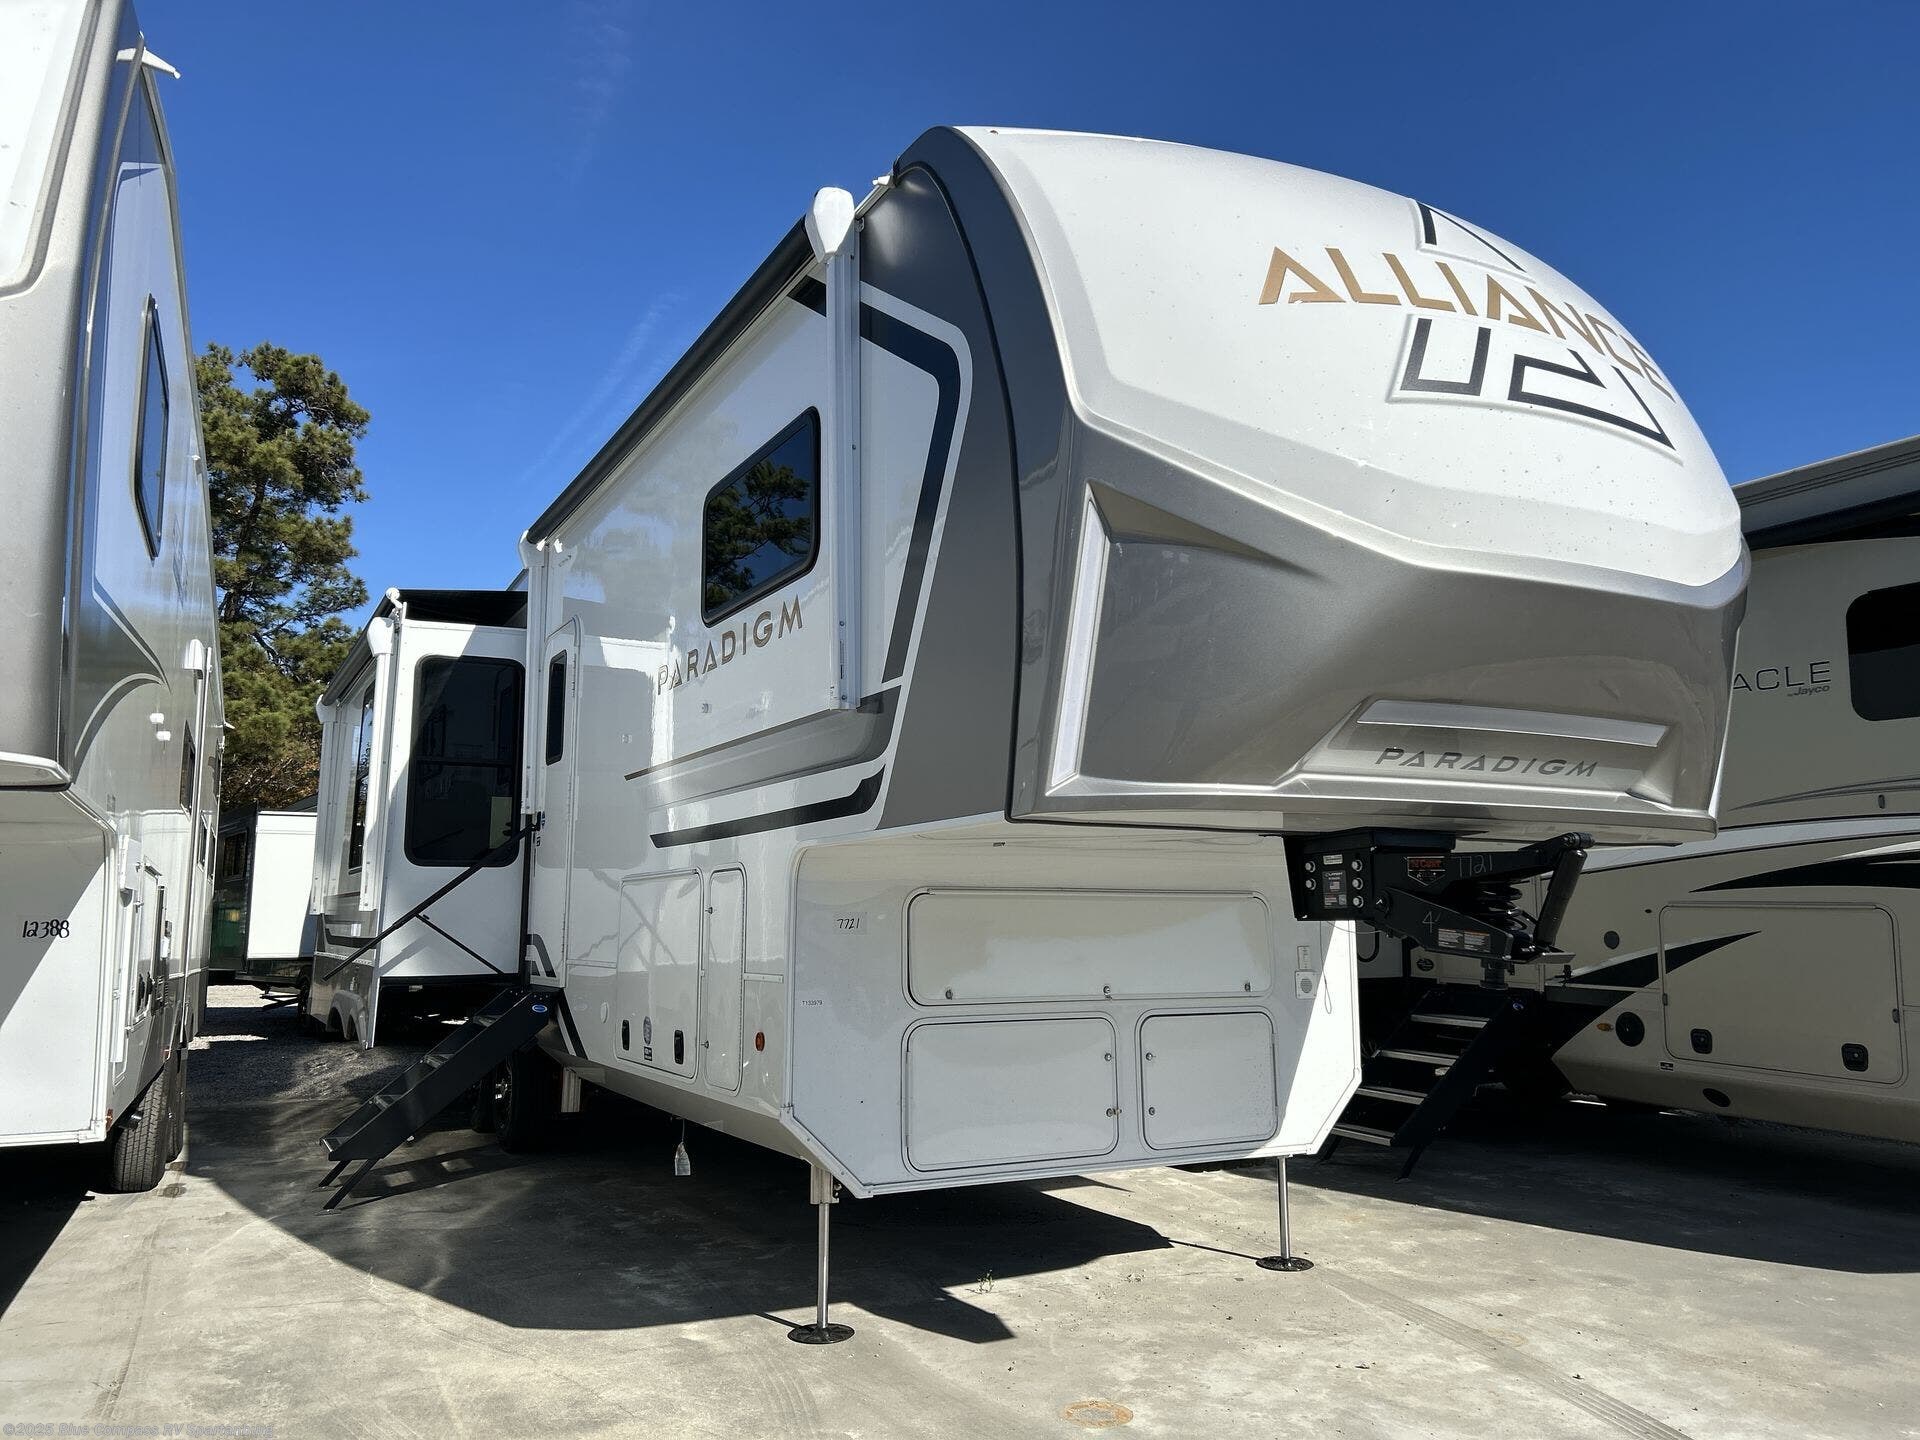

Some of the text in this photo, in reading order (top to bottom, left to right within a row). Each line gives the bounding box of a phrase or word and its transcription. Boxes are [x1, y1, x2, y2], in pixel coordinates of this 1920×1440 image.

[1259, 246, 1677, 404] ALLIANCE
[657, 595, 803, 695] PARADIGM
[1375, 747, 1598, 777] PARADIGM
[22, 919, 70, 938] 12388
[836, 918, 860, 929] 7721
